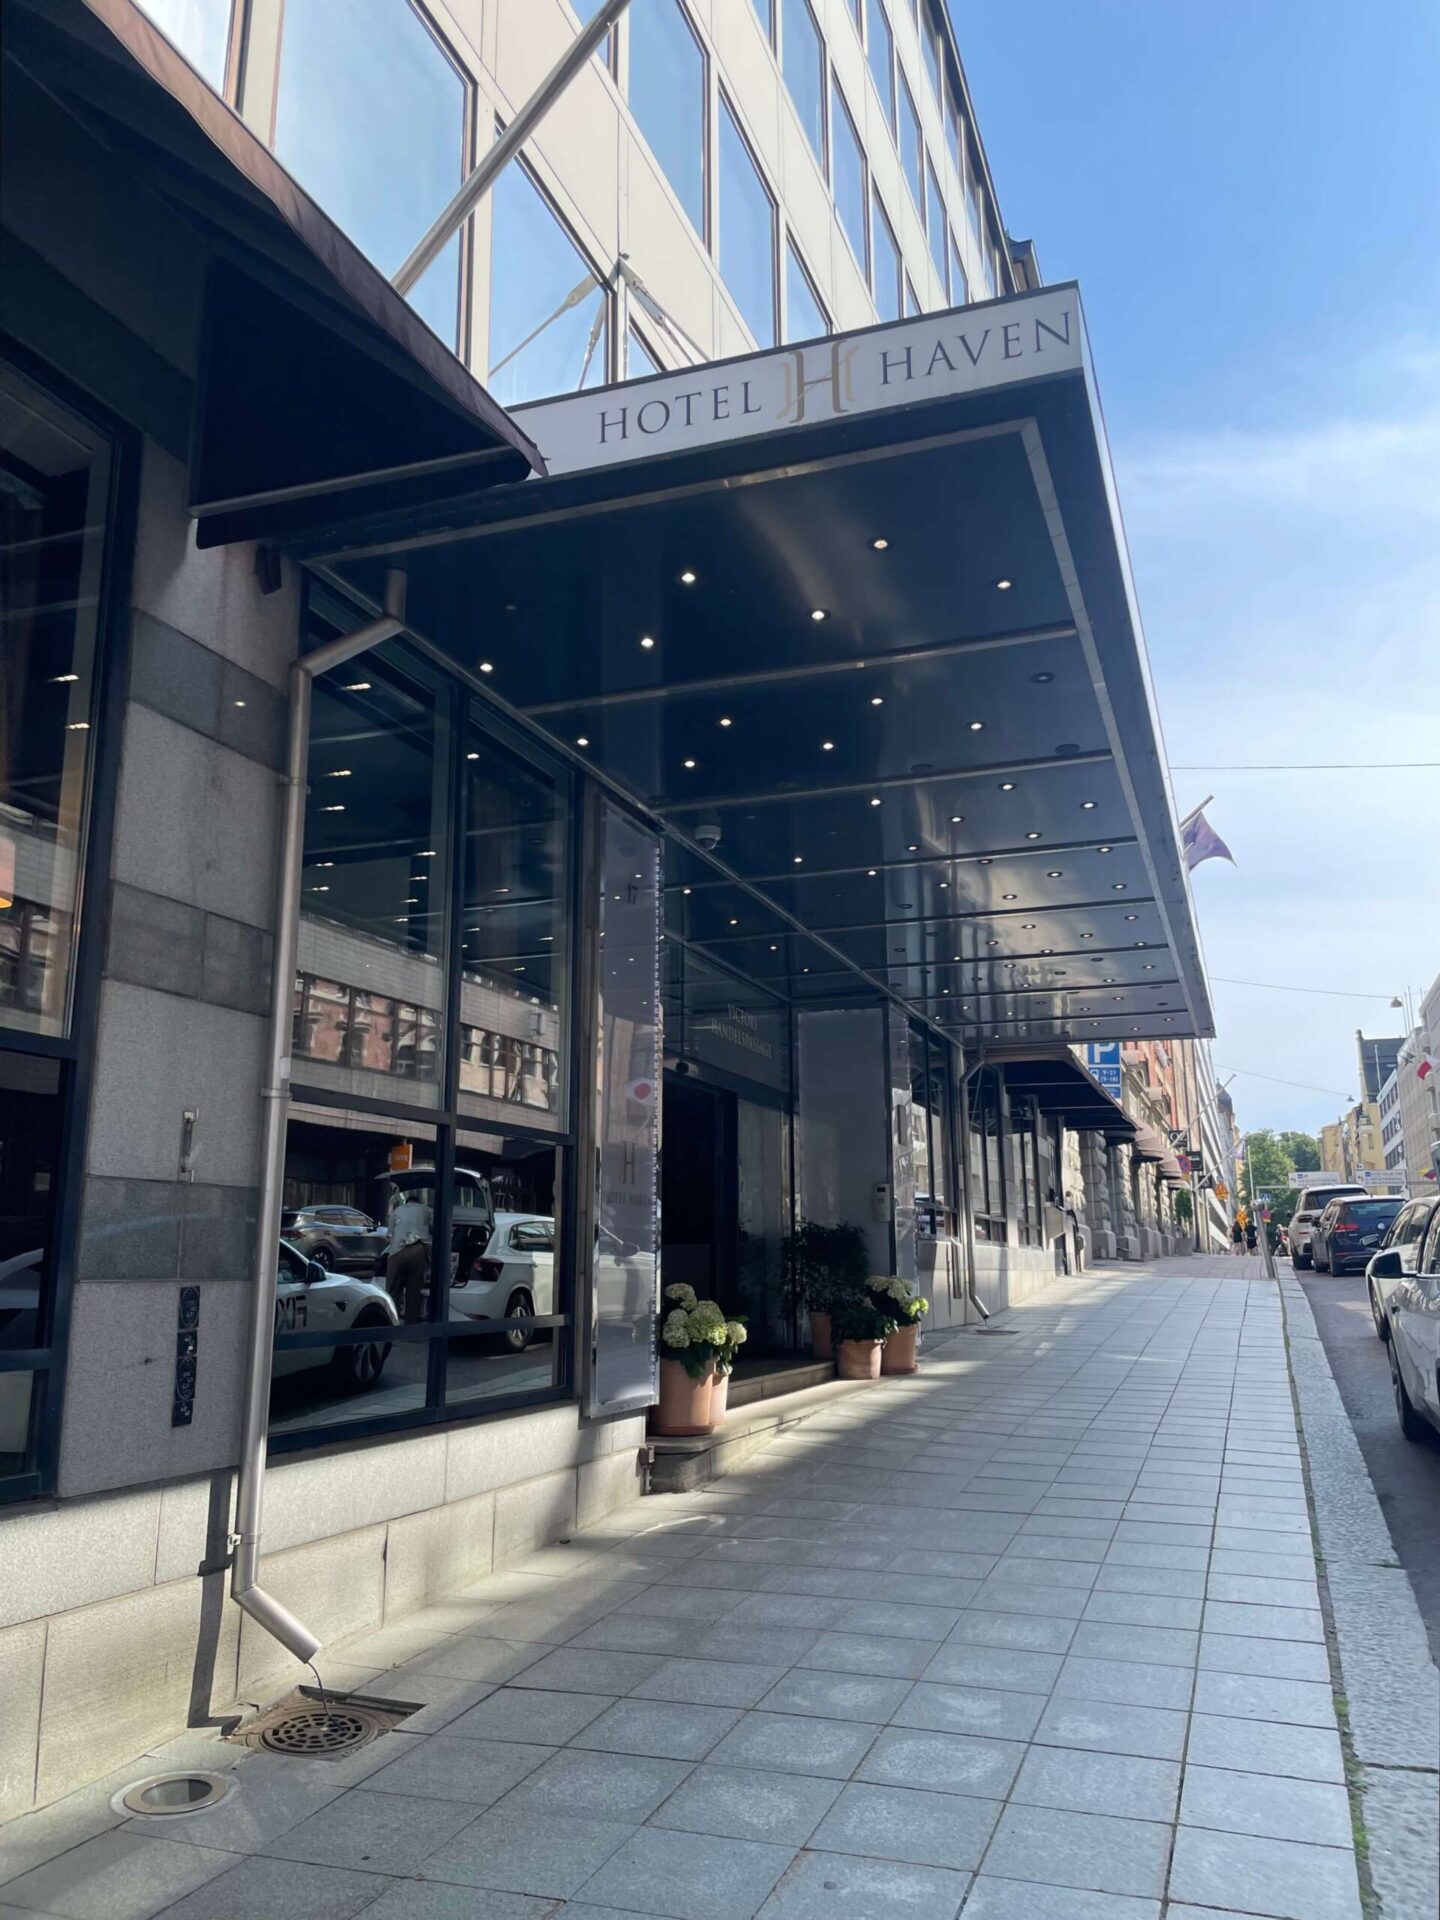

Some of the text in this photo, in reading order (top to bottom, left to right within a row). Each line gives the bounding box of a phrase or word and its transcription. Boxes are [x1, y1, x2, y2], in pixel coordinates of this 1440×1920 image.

[599, 380, 763, 444] HOTEL
[879, 311, 1071, 385] HAVEN
[1093, 1042, 1116, 1063] P
